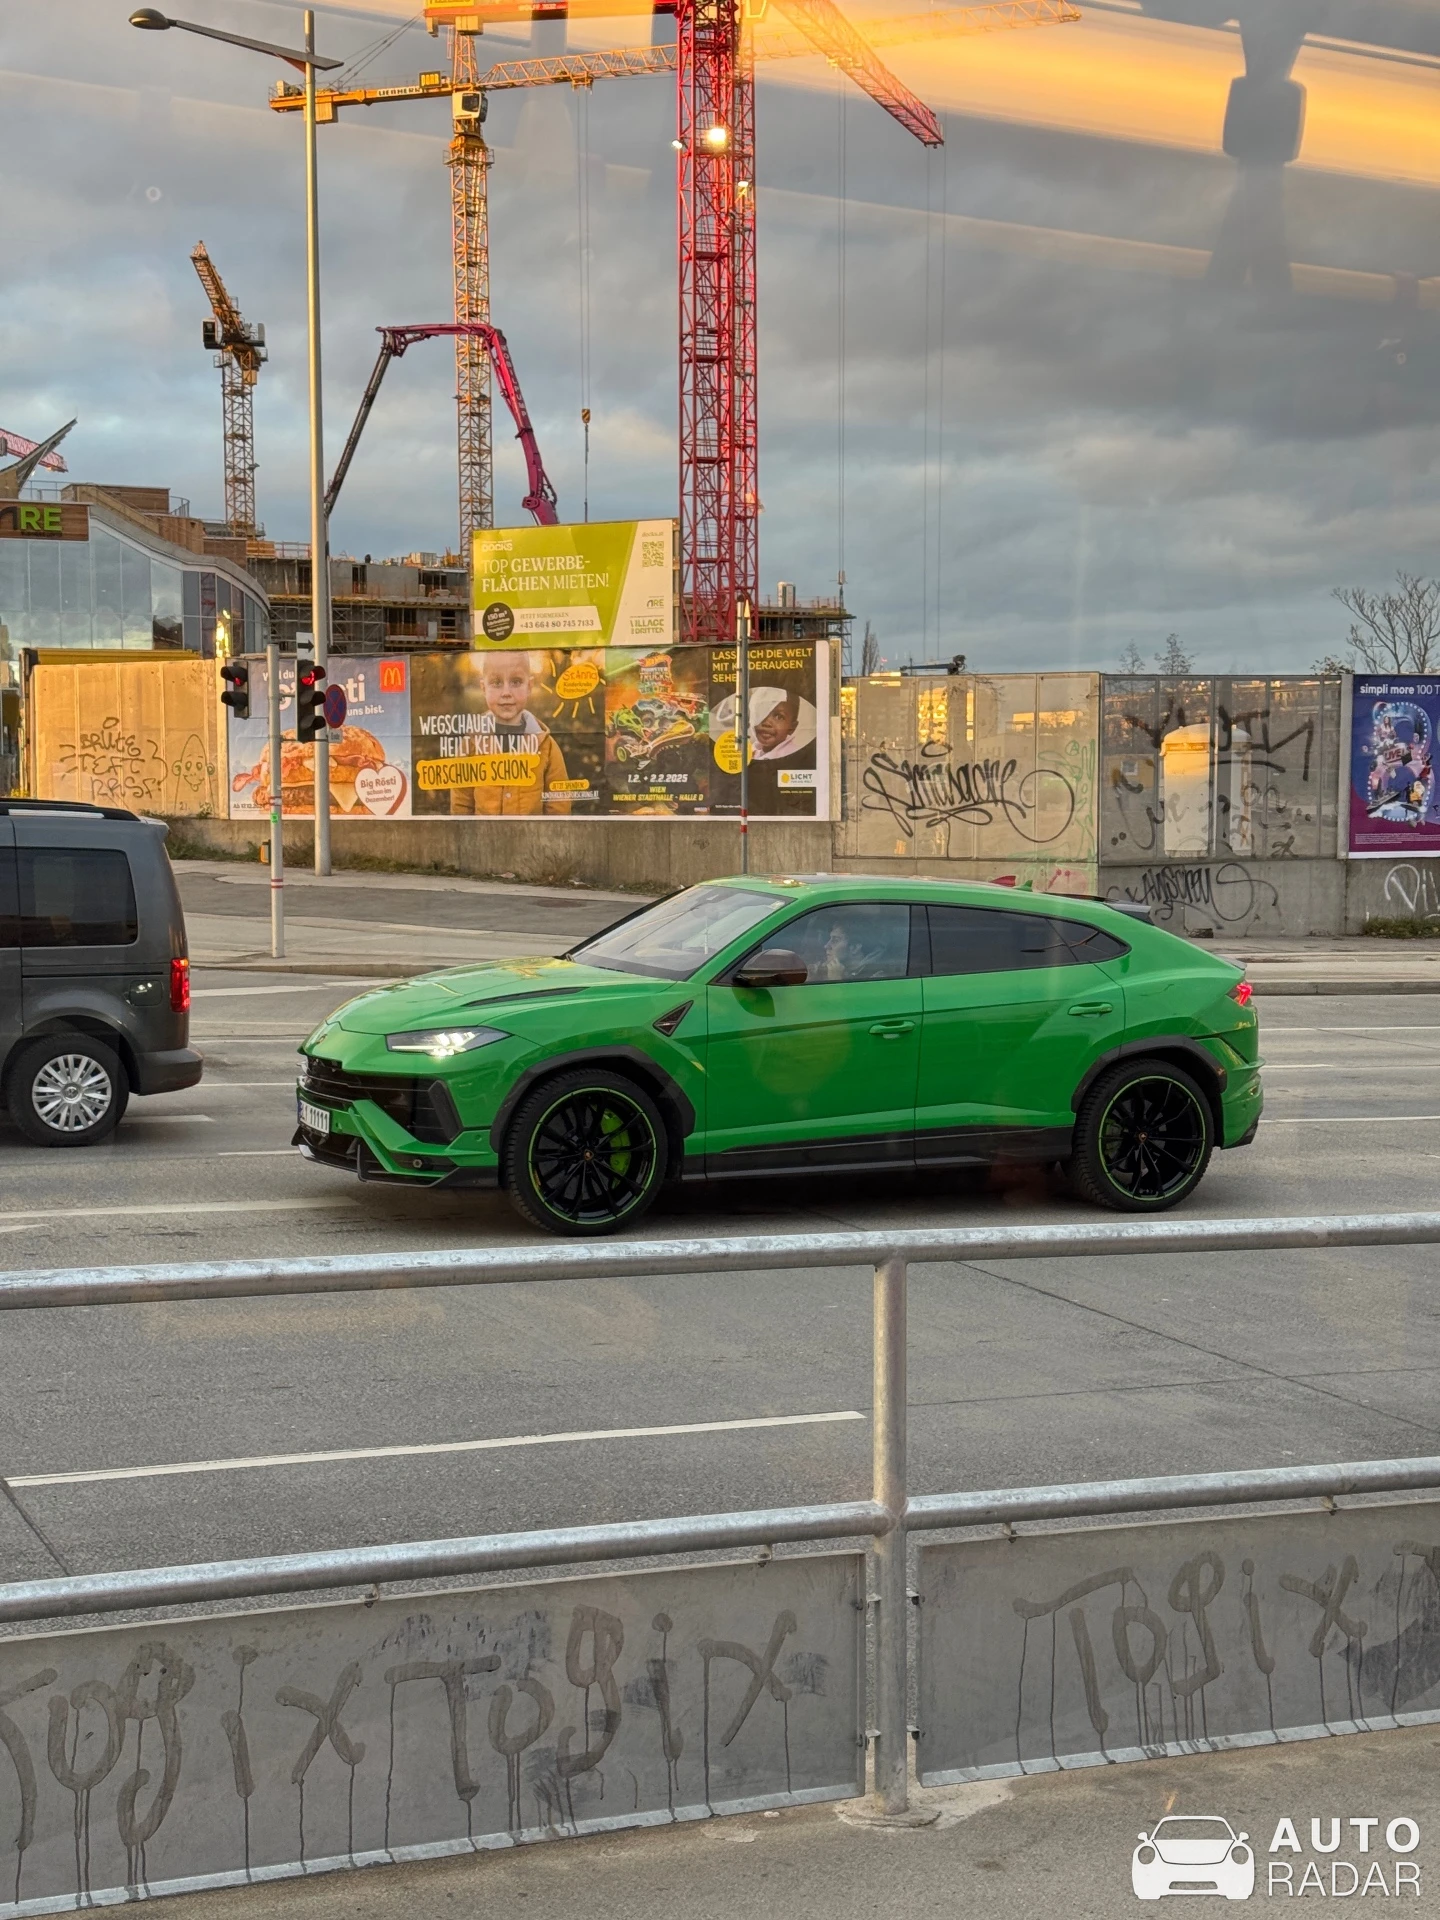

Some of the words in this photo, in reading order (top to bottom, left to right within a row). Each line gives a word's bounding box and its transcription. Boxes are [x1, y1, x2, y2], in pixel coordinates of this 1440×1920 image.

[482, 543, 512, 551] DOCKS
[482, 560, 508, 574] TOP
[511, 555, 590, 572] GEWERBE-
[482, 575, 550, 593] FLÄCHEN
[553, 573, 609, 590] MIETEN!
[577, 619, 594, 627] 7133
[712, 651, 736, 660] LASS
[747, 650, 764, 659] ICH
[766, 649, 782, 658] DIE
[785, 648, 813, 658] WELT
[712, 662, 728, 671] MIT
[283, 670, 295, 679] du
[712, 674, 737, 683] SEHE
[1360, 683, 1389, 696] simpli
[1390, 686, 1415, 695] more
[1416, 684, 1433, 695] 100
[347, 707, 363, 716] uns
[365, 705, 385, 715] bist.
[419, 714, 496, 735] WEGSCHAUEN
[439, 735, 470, 758] HEILT
[474, 735, 503, 756] KEIN
[508, 733, 541, 755] KIND.
[422, 762, 487, 785] FORSCHUNG
[491, 759, 532, 781] SCHON.
[361, 779, 373, 789] Big
[375, 776, 396, 786] Rösti
[628, 774, 641, 783] 1.2.
[650, 773, 688, 783] 2.2.2025
[679, 793, 697, 801] HALLE
